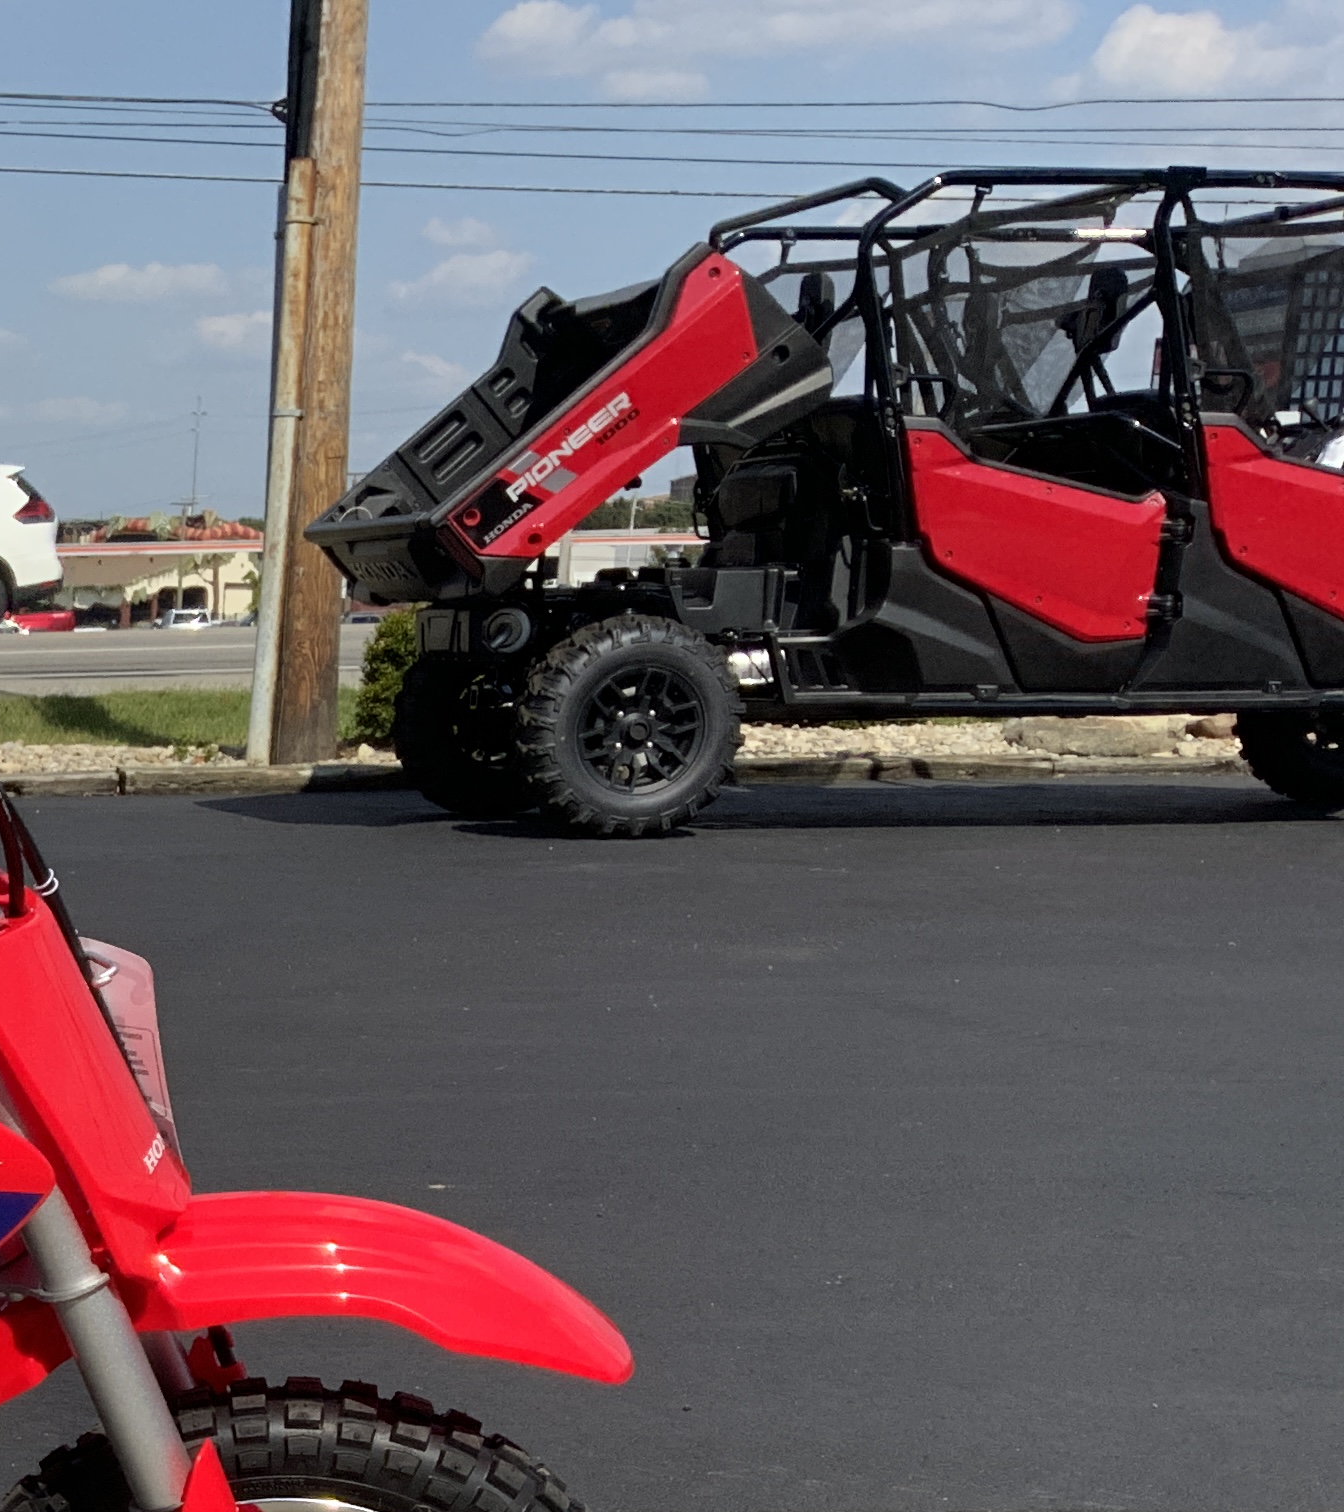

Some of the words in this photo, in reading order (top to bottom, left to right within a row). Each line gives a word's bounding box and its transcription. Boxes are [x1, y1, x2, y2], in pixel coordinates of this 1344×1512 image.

[505, 391, 632, 503] PIONEER
[595, 408, 640, 446] 1000
[482, 502, 534, 545] HONDA
